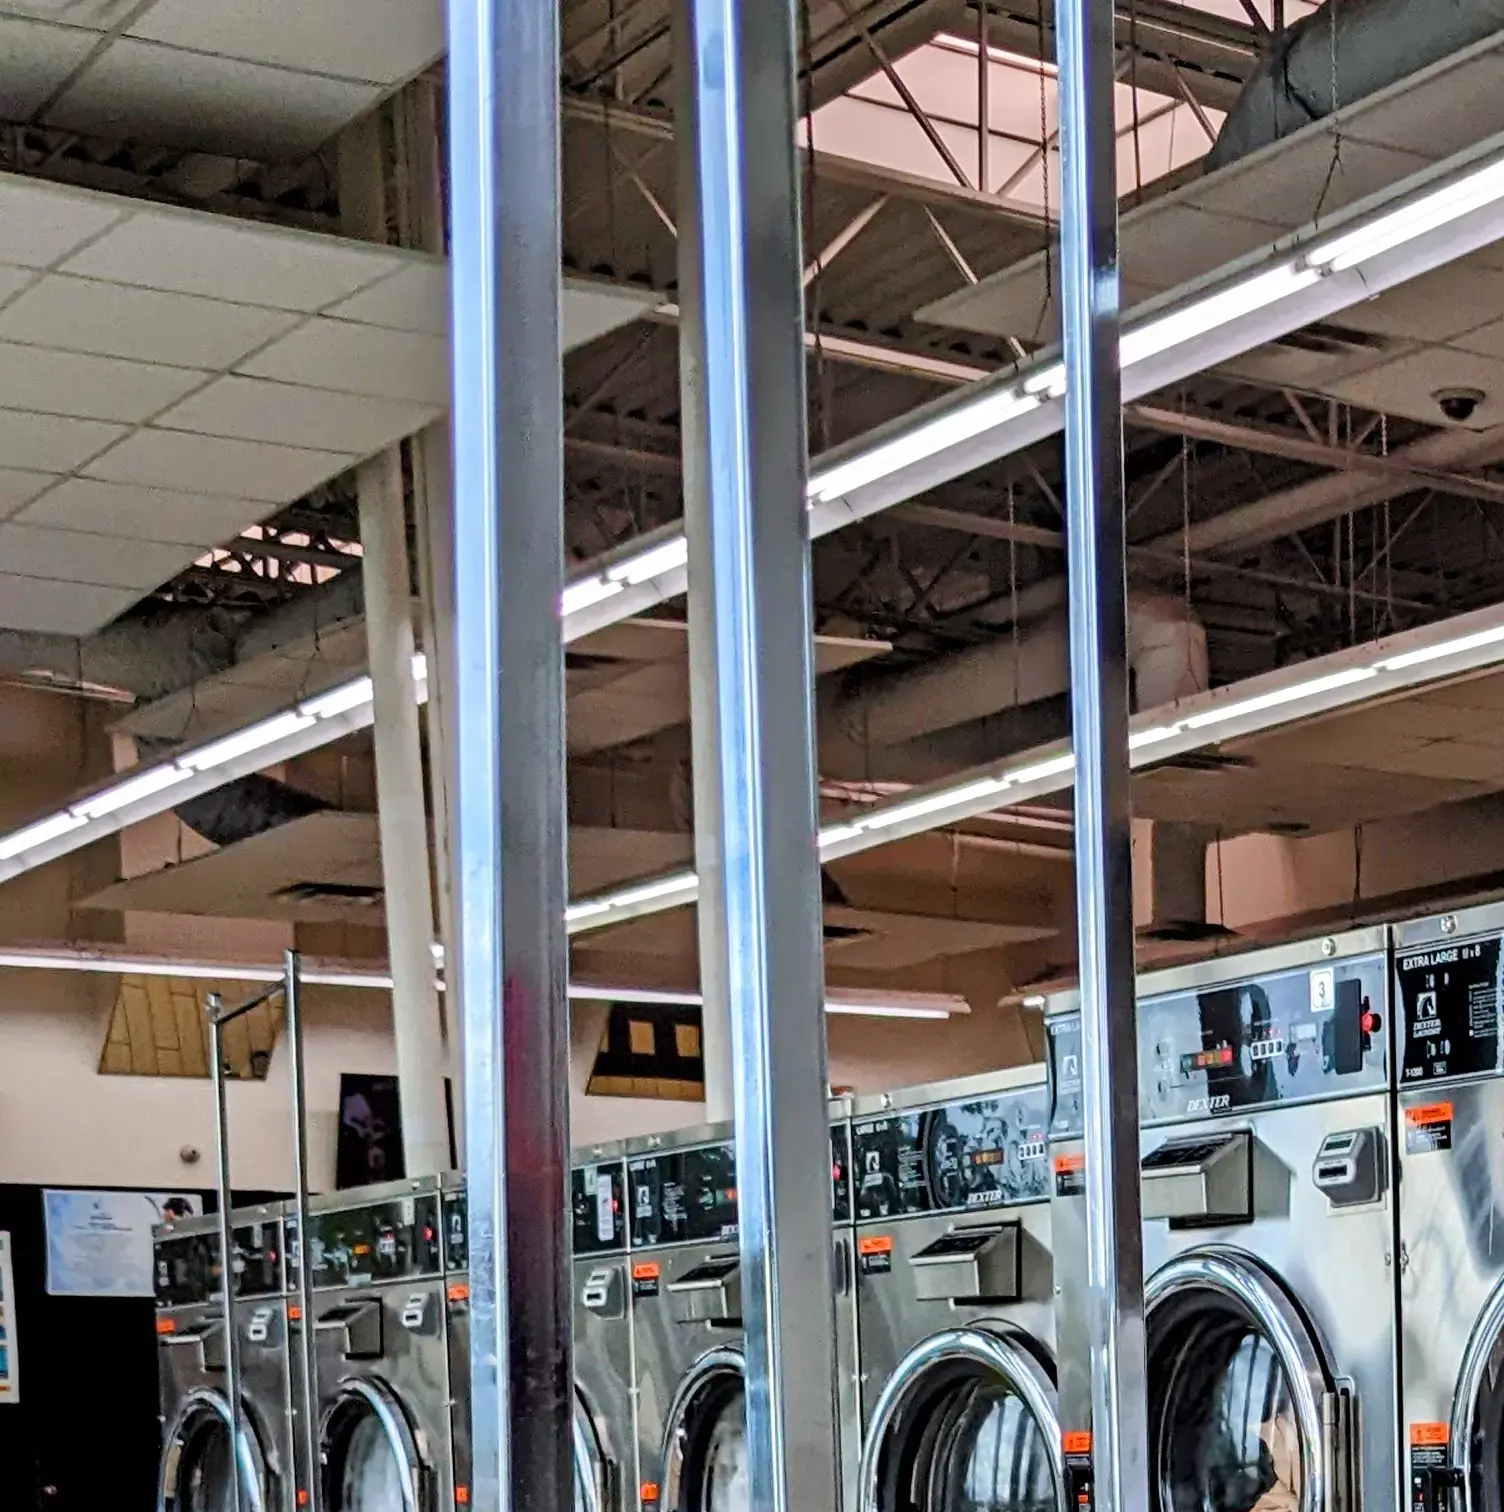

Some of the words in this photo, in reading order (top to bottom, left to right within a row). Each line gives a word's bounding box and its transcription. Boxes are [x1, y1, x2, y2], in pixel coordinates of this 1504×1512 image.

[1403, 957, 1430, 971] EXTRA
[1430, 949, 1459, 966] LARGE
[1319, 980, 1326, 999] 3
[1188, 1095, 1230, 1111] DEXTER
